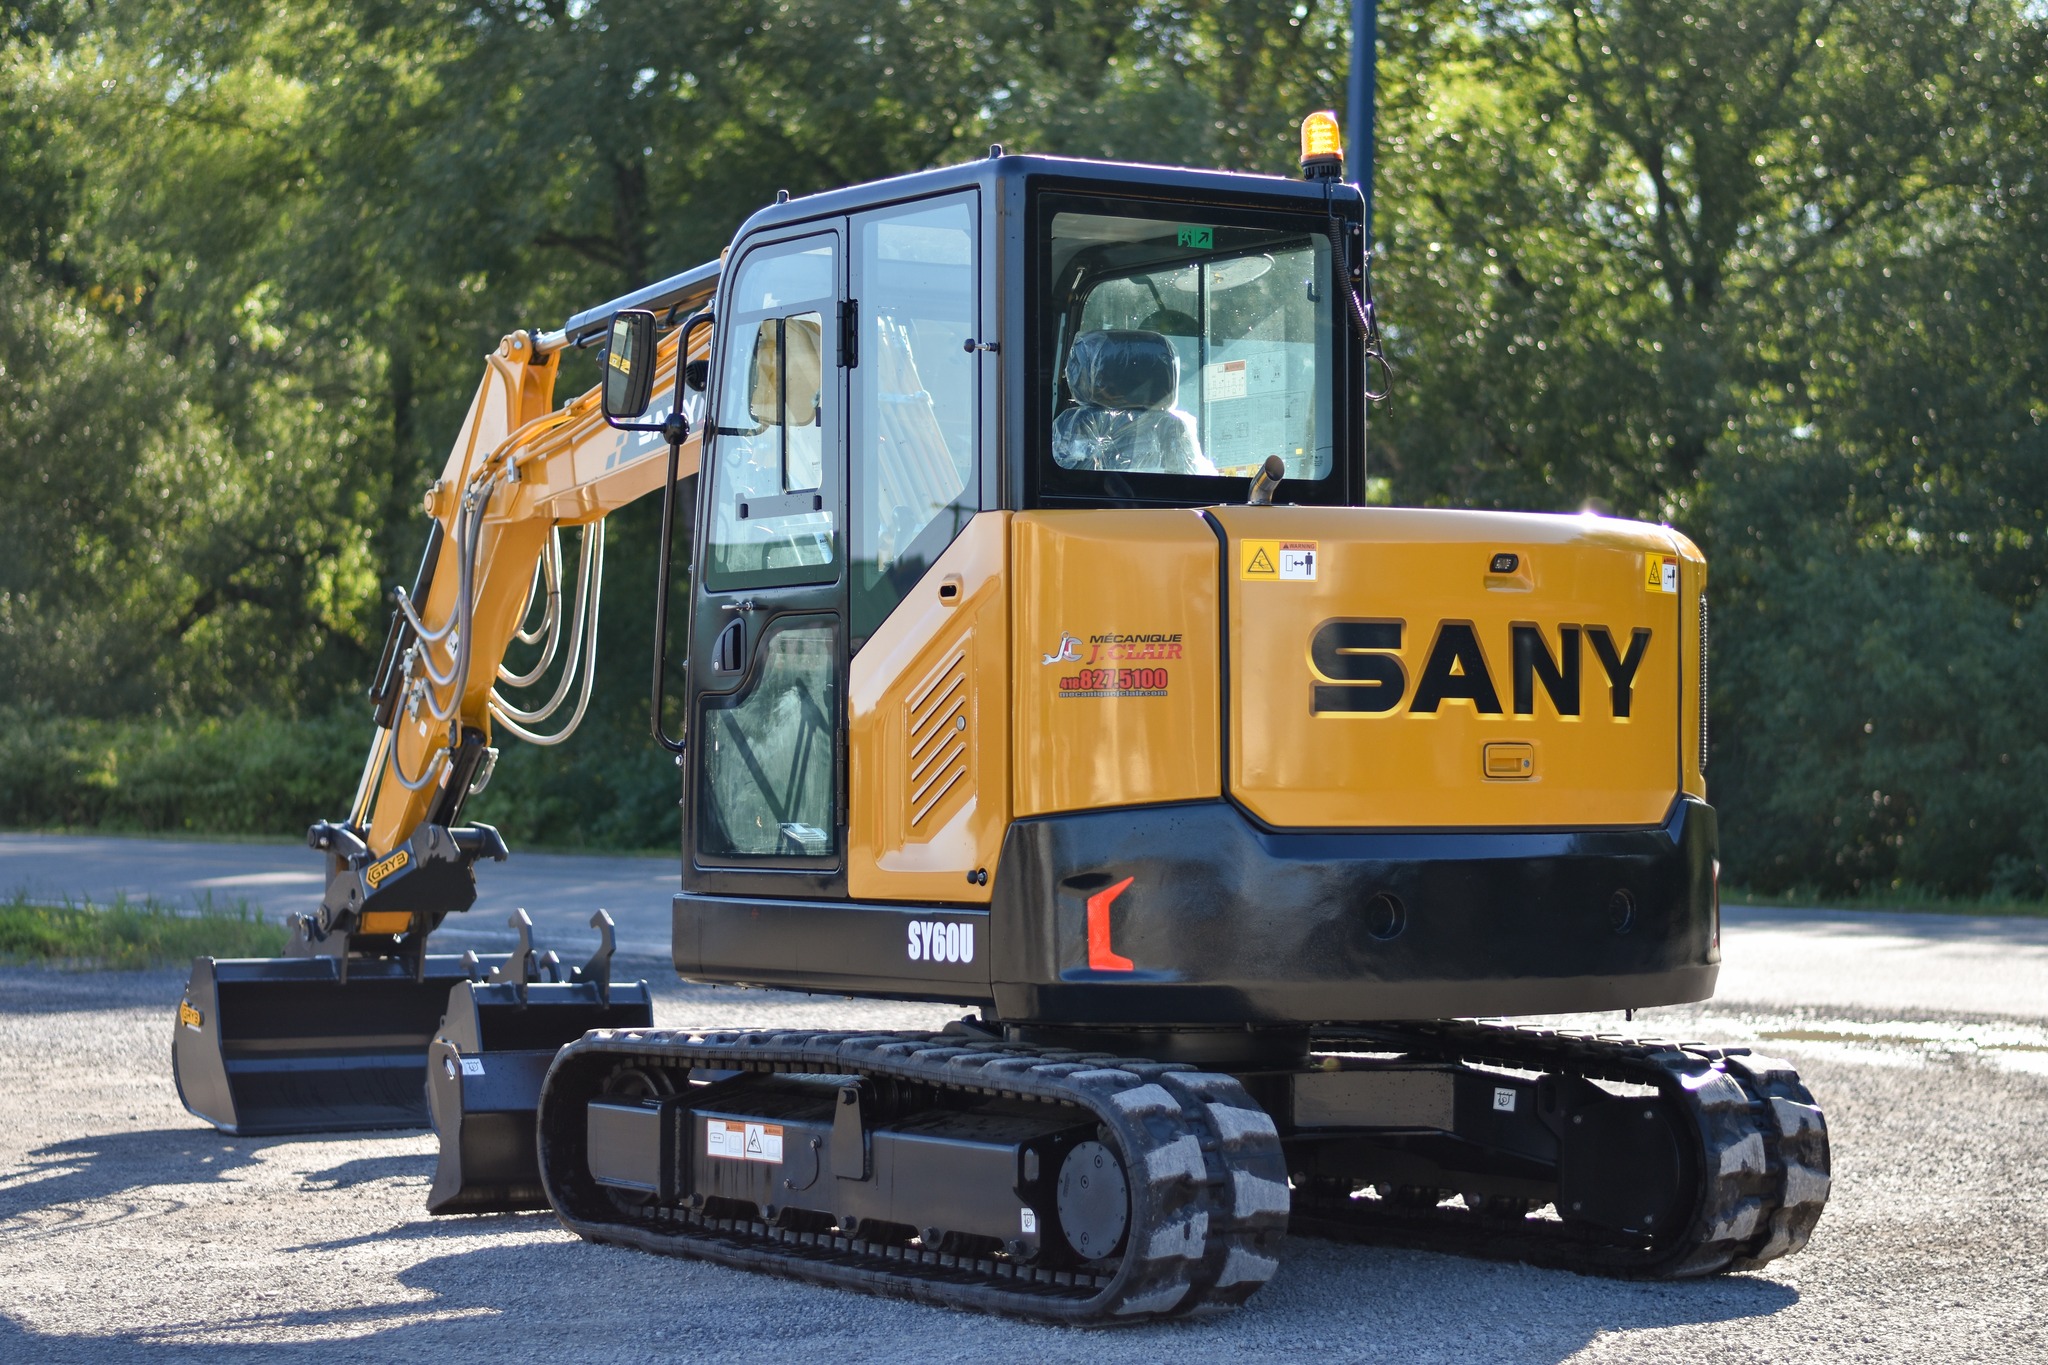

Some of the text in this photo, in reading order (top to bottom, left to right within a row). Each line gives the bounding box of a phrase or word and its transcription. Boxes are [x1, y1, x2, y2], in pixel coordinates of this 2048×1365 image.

[638, 394, 698, 446] SAY
[1089, 633, 1183, 644] MÉCANIQUE
[1308, 617, 1653, 722] SANY
[907, 920, 974, 963] SY60U
